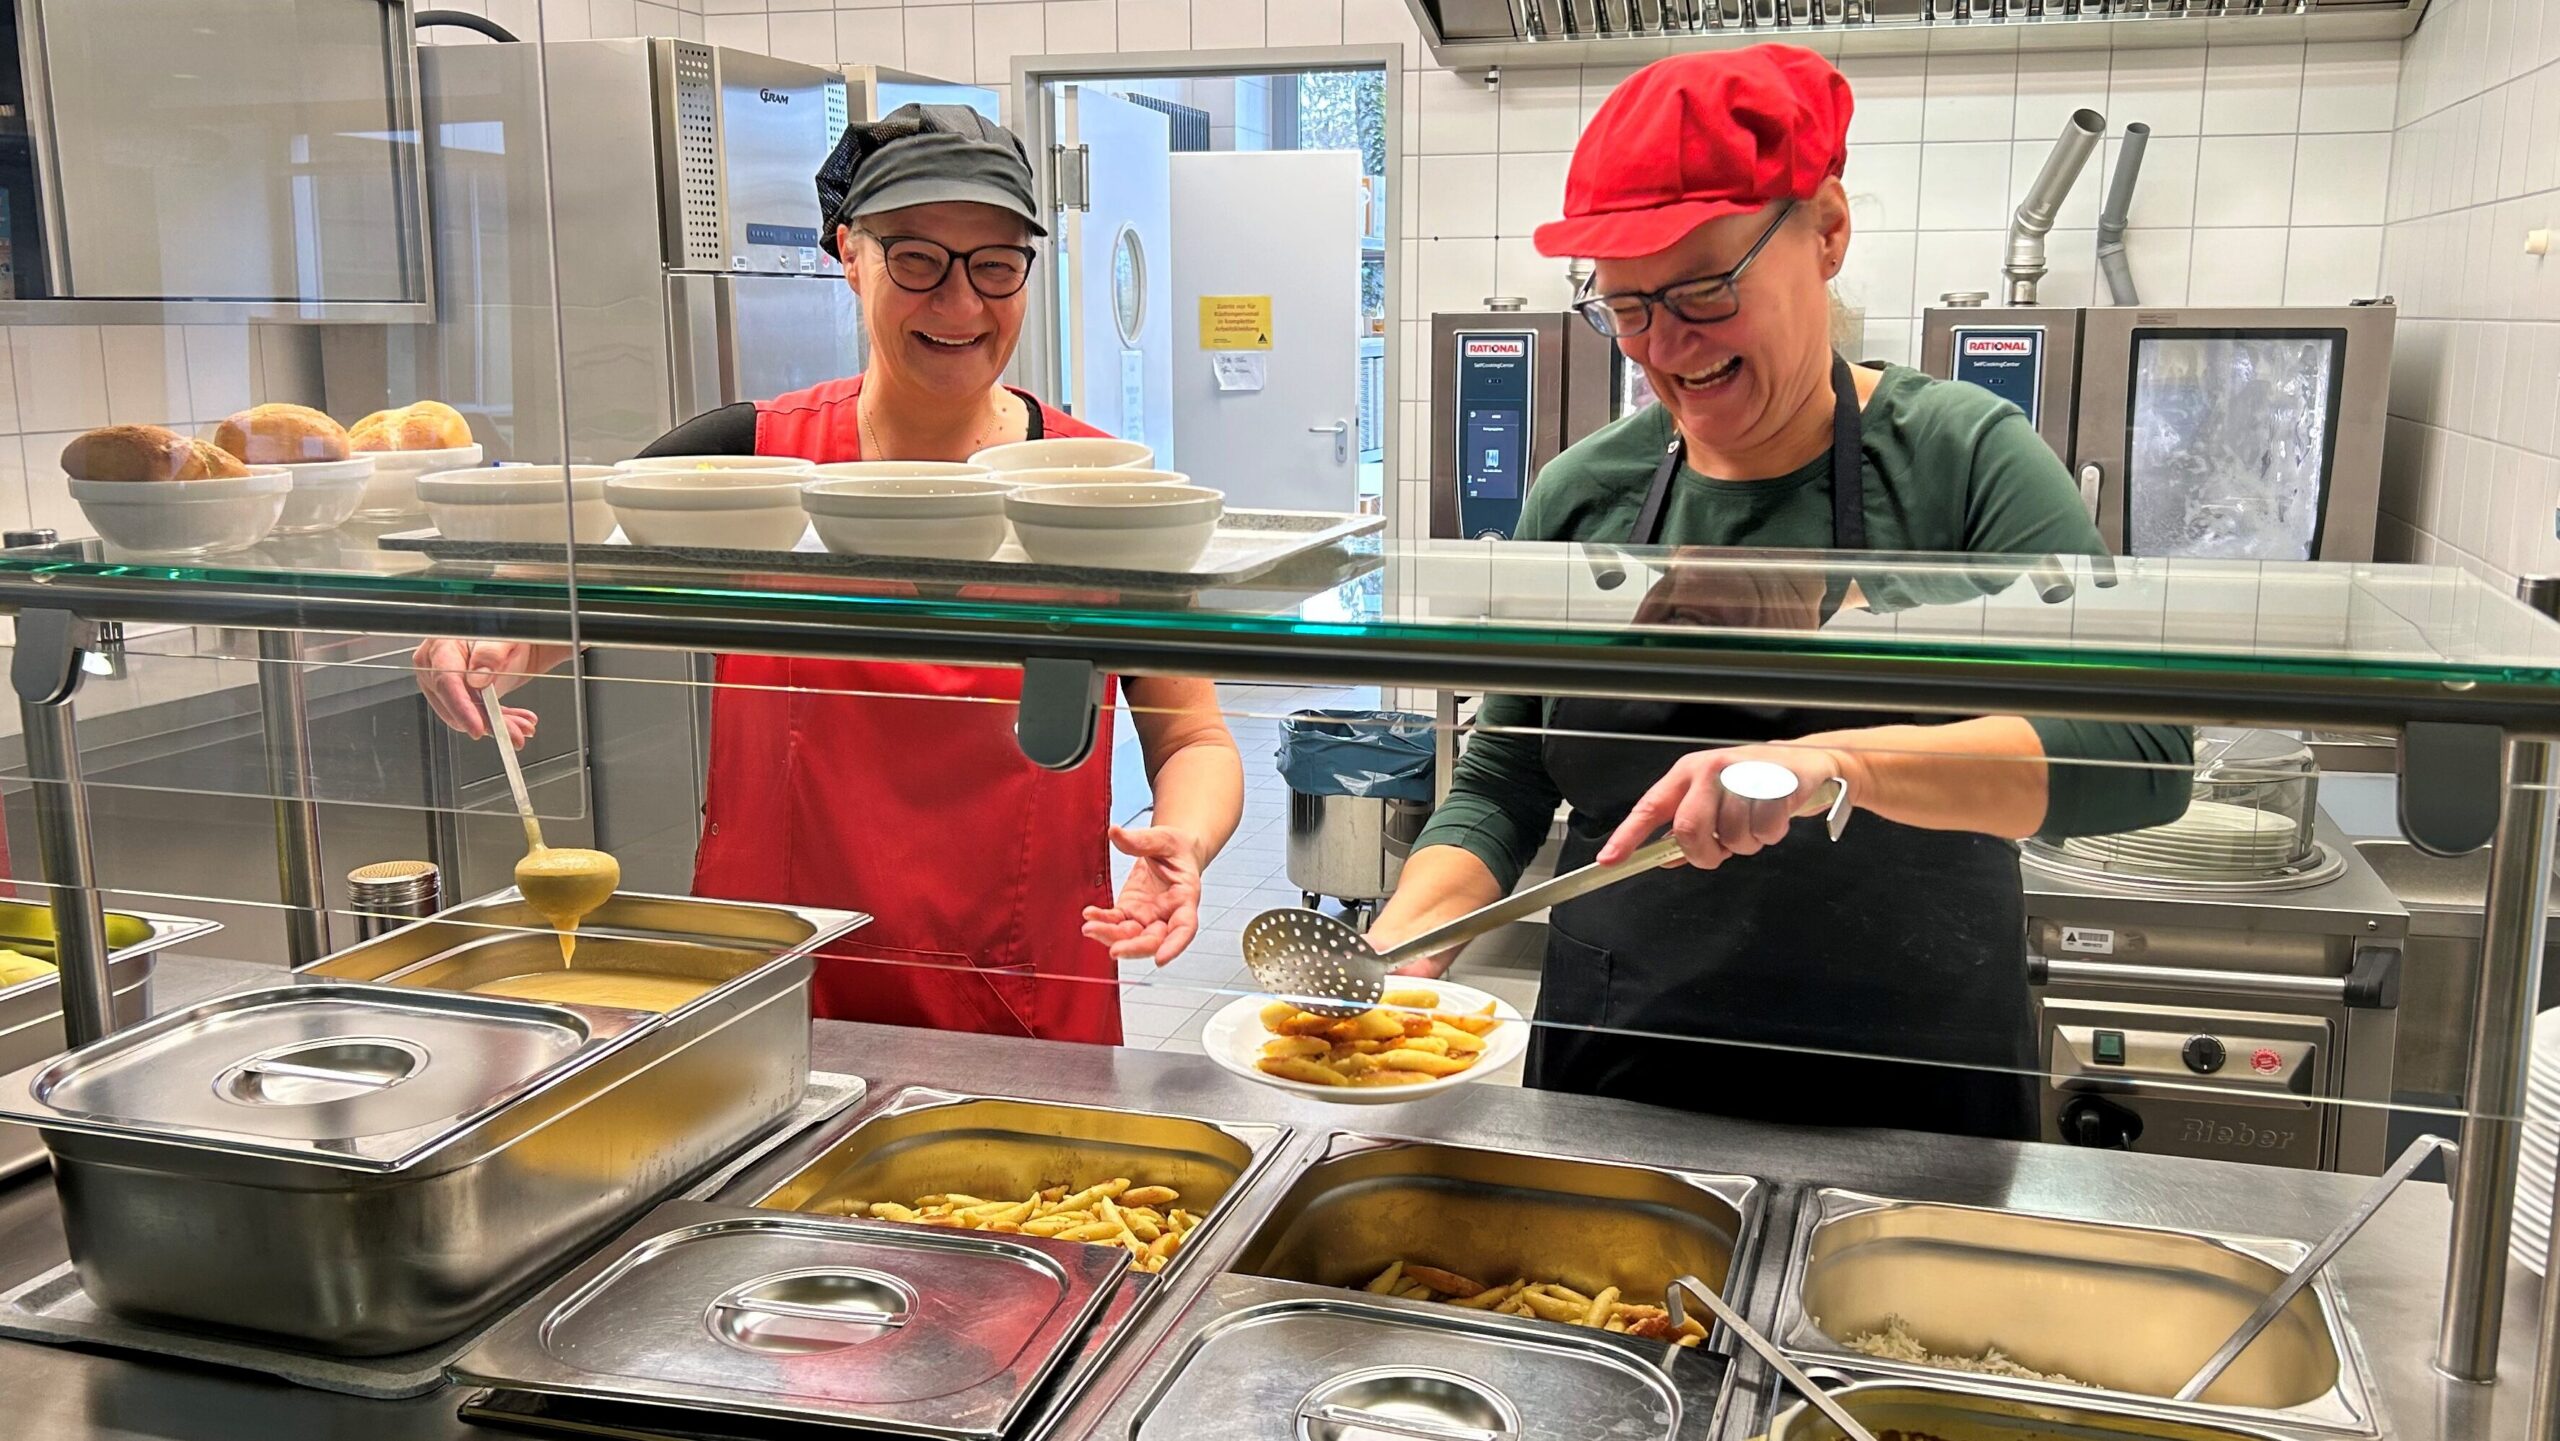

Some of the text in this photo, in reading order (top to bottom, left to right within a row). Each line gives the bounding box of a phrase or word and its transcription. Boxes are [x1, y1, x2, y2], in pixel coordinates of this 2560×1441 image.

[760, 87, 789, 105] GRAM
[1470, 344, 1520, 353] RATIONAL
[1969, 342, 2027, 351] RATIONAL
[2179, 1116, 2295, 1149] Rieber
